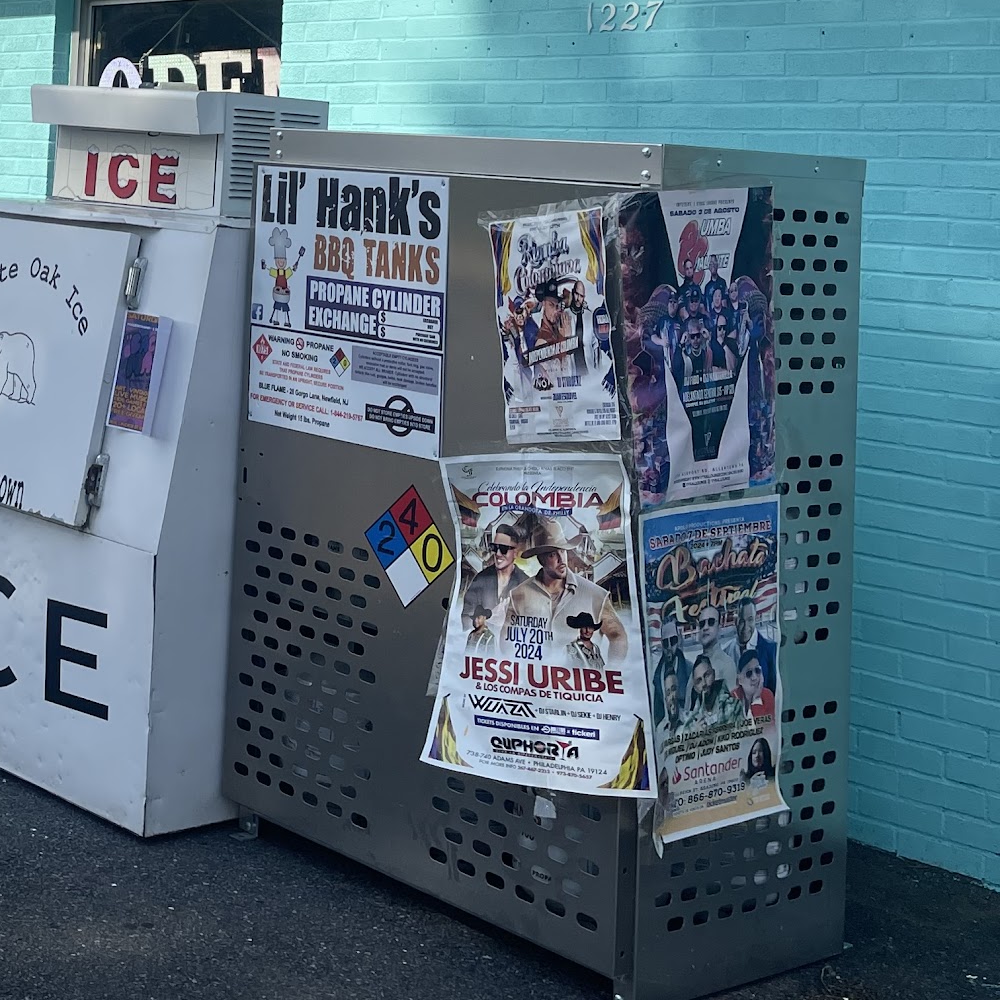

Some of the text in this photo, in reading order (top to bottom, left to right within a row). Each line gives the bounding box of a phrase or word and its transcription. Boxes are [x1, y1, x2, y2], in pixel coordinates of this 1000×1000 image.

[587, 0, 664, 35] 1227
[84, 147, 180, 205] ICE
[316, 177, 441, 239] Hank's
[313, 234, 440, 285] BBQ TANKS
[30, 257, 61, 289] Oak
[65, 285, 88, 336] Ice
[310, 280, 441, 317] PROPANE CYLINDER
[308, 306, 376, 336] EXCHANGE
[380, 311, 386, 323] $
[380, 326, 386, 337] $
[268, 335, 334, 352] WARNING PROPANE
[291, 351, 318, 362] SMOKING
[259, 382, 271, 390] BLUE
[271, 385, 286, 393] FLAME
[260, 394, 287, 406] EMERGENCY
[296, 402, 315, 411] SERVICE
[282, 411, 297, 420] Weight
[311, 418, 330, 427] Propane
[478, 481, 597, 494] Celebrando la Independencia
[472, 491, 604, 508] COLOMBIA
[398, 498, 418, 535] 4
[377, 520, 395, 555] 2
[694, 529, 709, 539] DE
[710, 519, 771, 537] SEPTIEMBRE
[422, 534, 443, 572] 0
[656, 537, 769, 590] Bachata
[510, 615, 548, 628] SATURDAY
[505, 626, 553, 645] JULY 20TH
[514, 643, 543, 660] 2024
[459, 656, 624, 694] JESSI URIBE
[475, 682, 604, 703] & LOS COMPAS DE TIQUICIA
[477, 718, 494, 726] TICKETS
[495, 720, 530, 730] DISPONIBLES
[602, 713, 621, 721] HENRY
[740, 718, 752, 727] JOE
[754, 715, 771, 725] VERAS
[731, 727, 764, 739] RODRIGUEZ
[700, 747, 714, 757] JUDY
[715, 742, 740, 753] SANTOS
[466, 750, 491, 759] 738-740
[533, 761, 576, 772] PHILADELPHIA
[588, 767, 607, 775] 19124
[683, 757, 742, 781] Santander
[695, 776, 716, 785] ARENA
[688, 782, 746, 804] 866-870-9319
